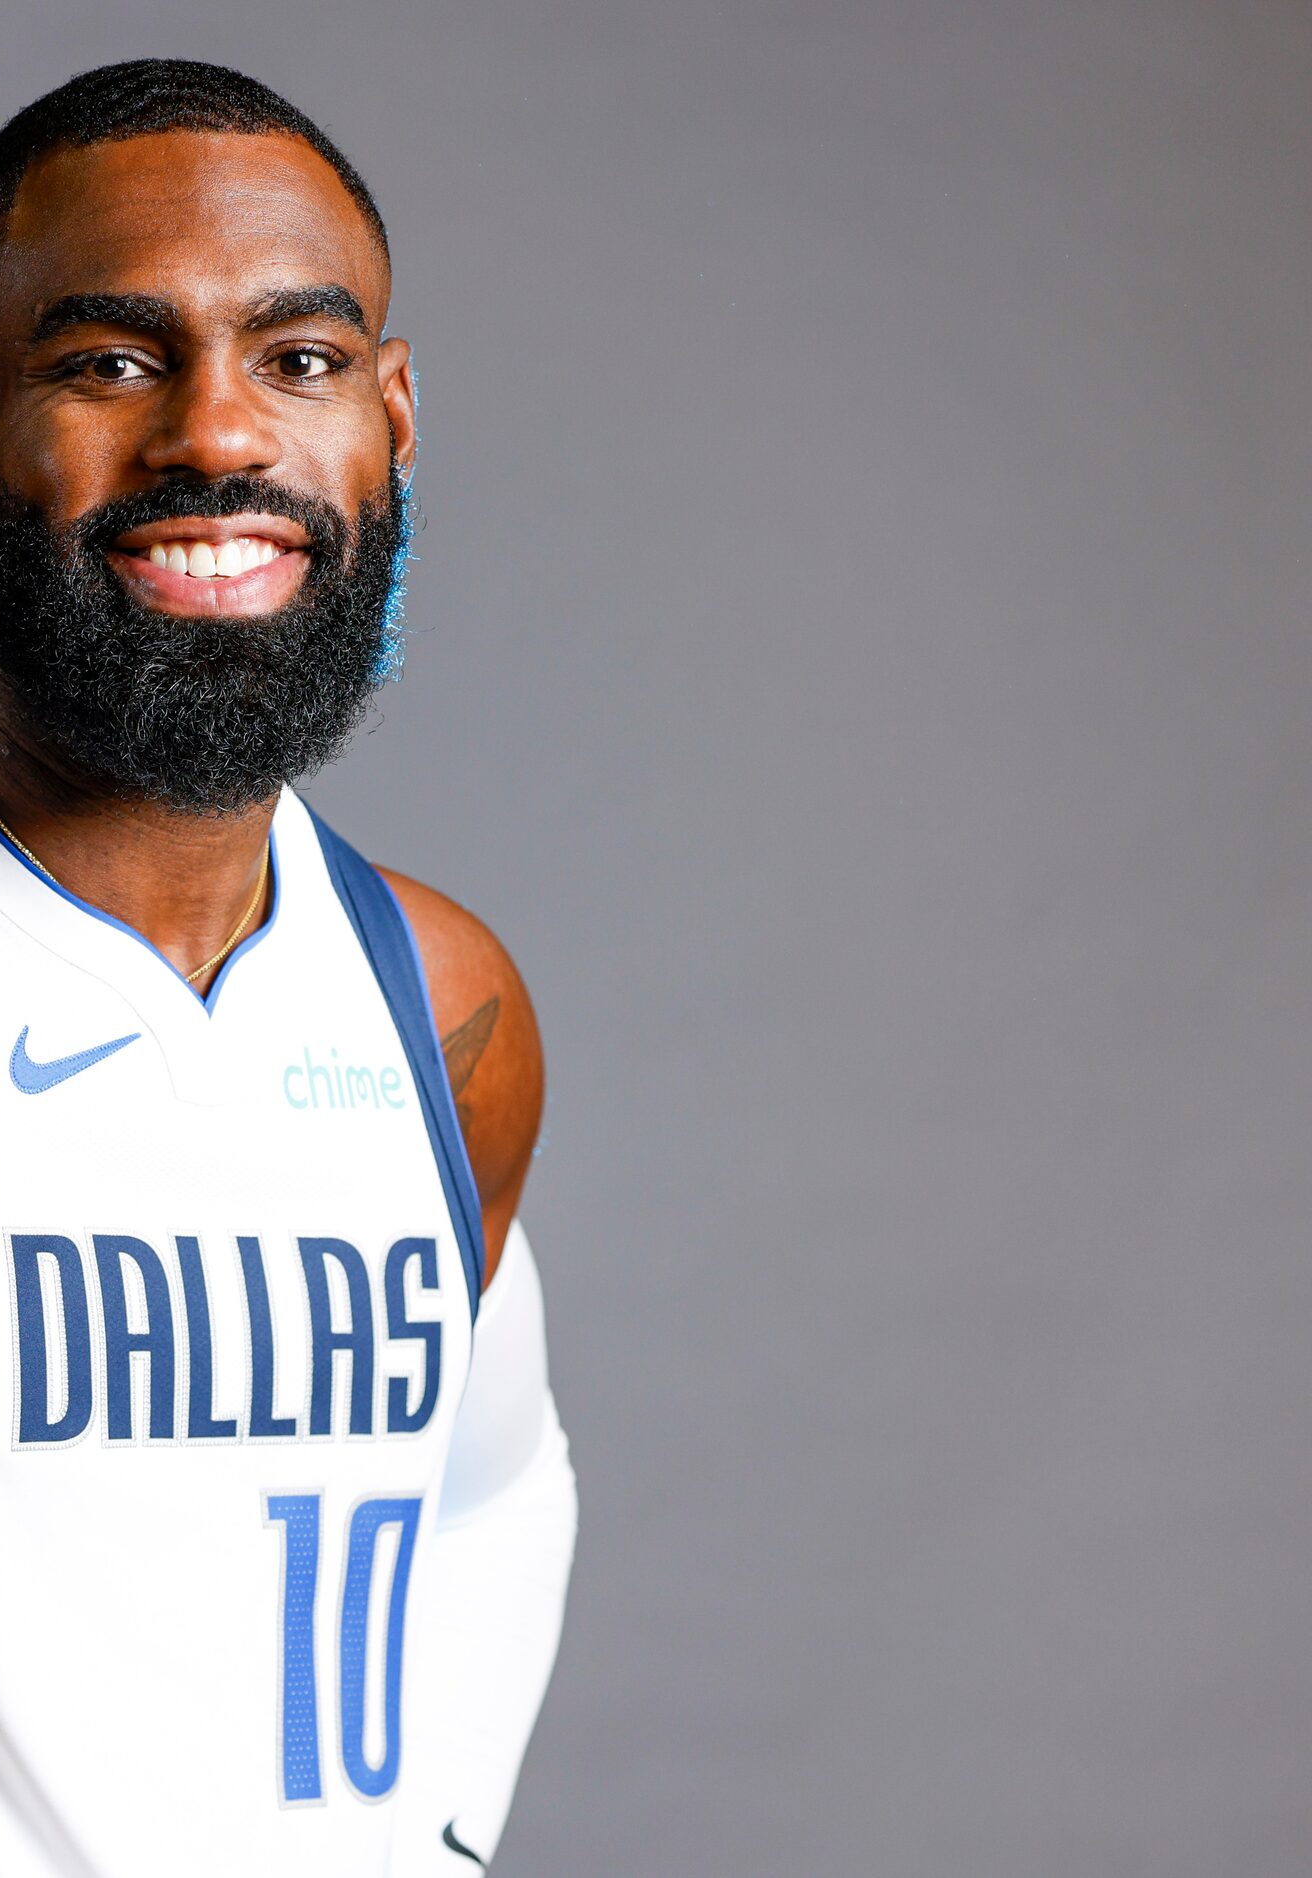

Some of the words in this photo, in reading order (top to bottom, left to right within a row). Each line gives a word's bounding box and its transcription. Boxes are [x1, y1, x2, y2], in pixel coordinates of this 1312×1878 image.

[283, 1046, 405, 1110] chime
[4, 1228, 443, 1449] DALLAS
[260, 1488, 424, 1809] 10
